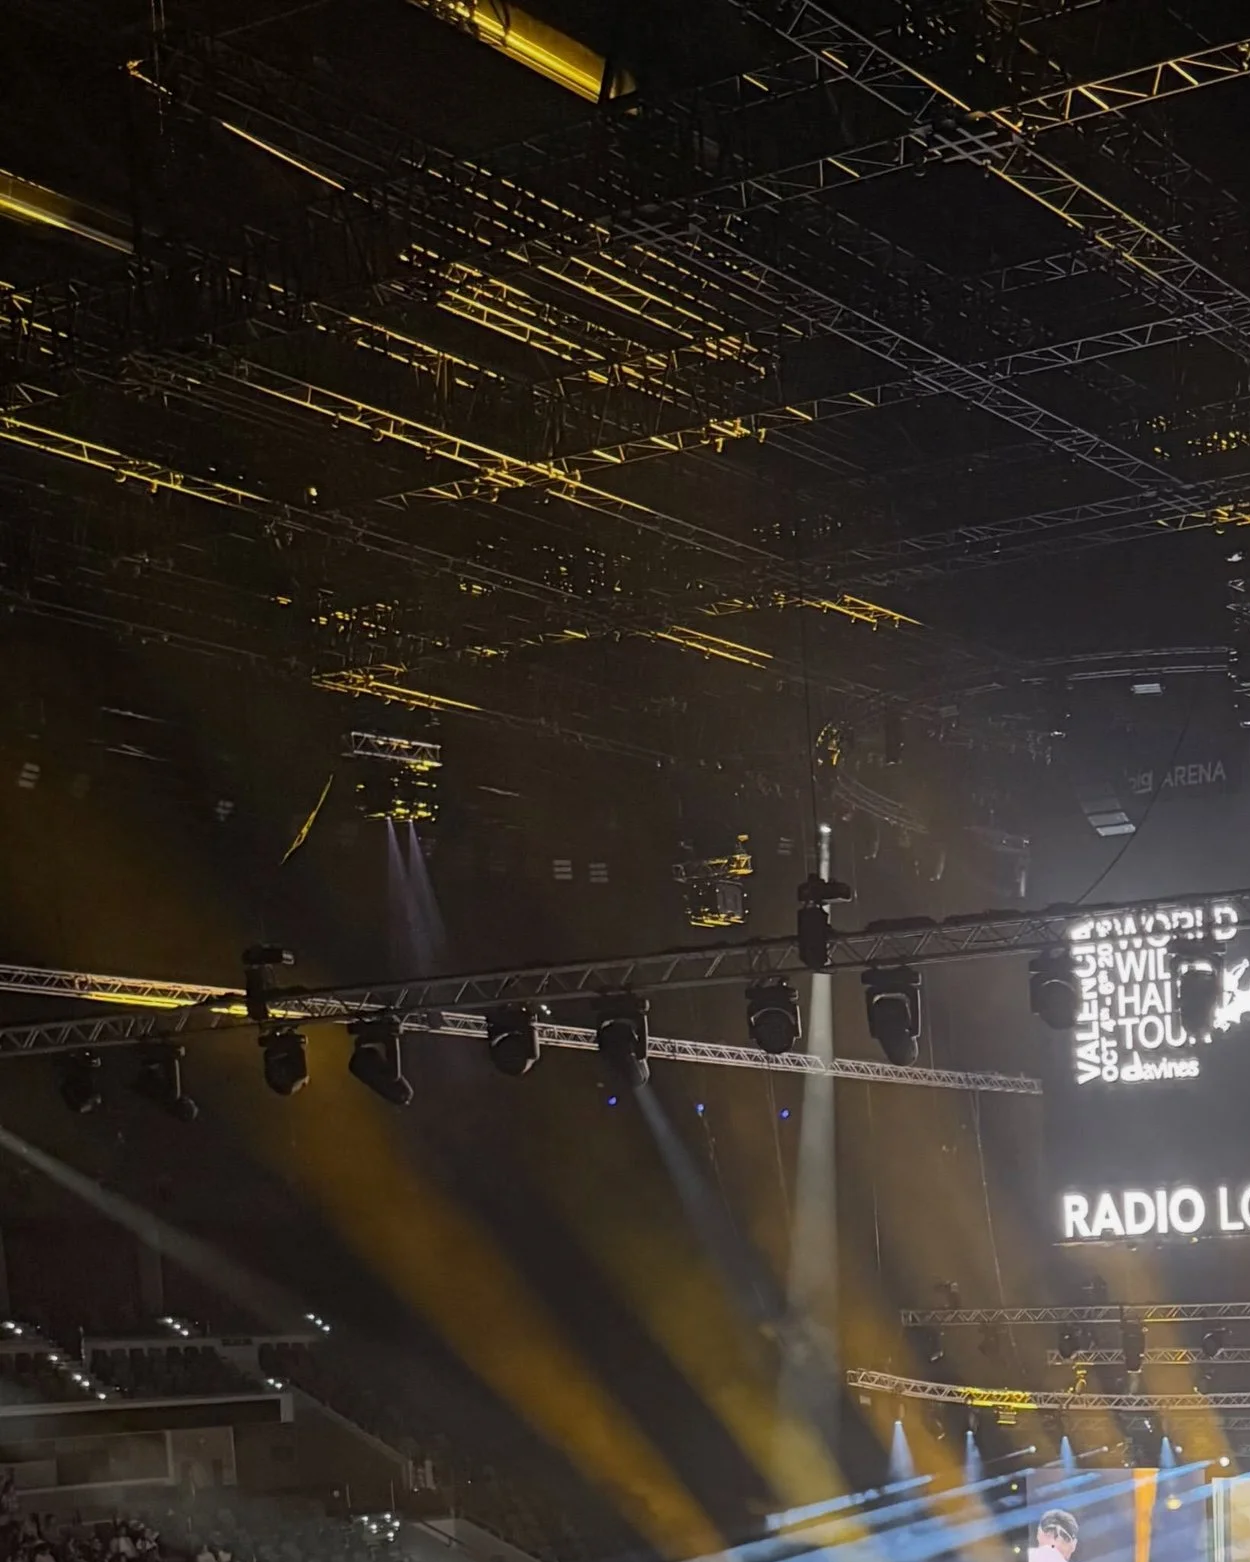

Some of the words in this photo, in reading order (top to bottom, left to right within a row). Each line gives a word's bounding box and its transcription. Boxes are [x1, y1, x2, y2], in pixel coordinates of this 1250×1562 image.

[1161, 760, 1227, 788] ARENA
[1114, 947, 1172, 984] WID
[1070, 919, 1101, 1085] VALENCIA
[1117, 981, 1173, 1017] HAI
[1117, 1014, 1212, 1050] TOU
[1101, 1036, 1119, 1082] OCT
[1120, 1051, 1200, 1082] davines
[1063, 1187, 1206, 1238] RADIO
